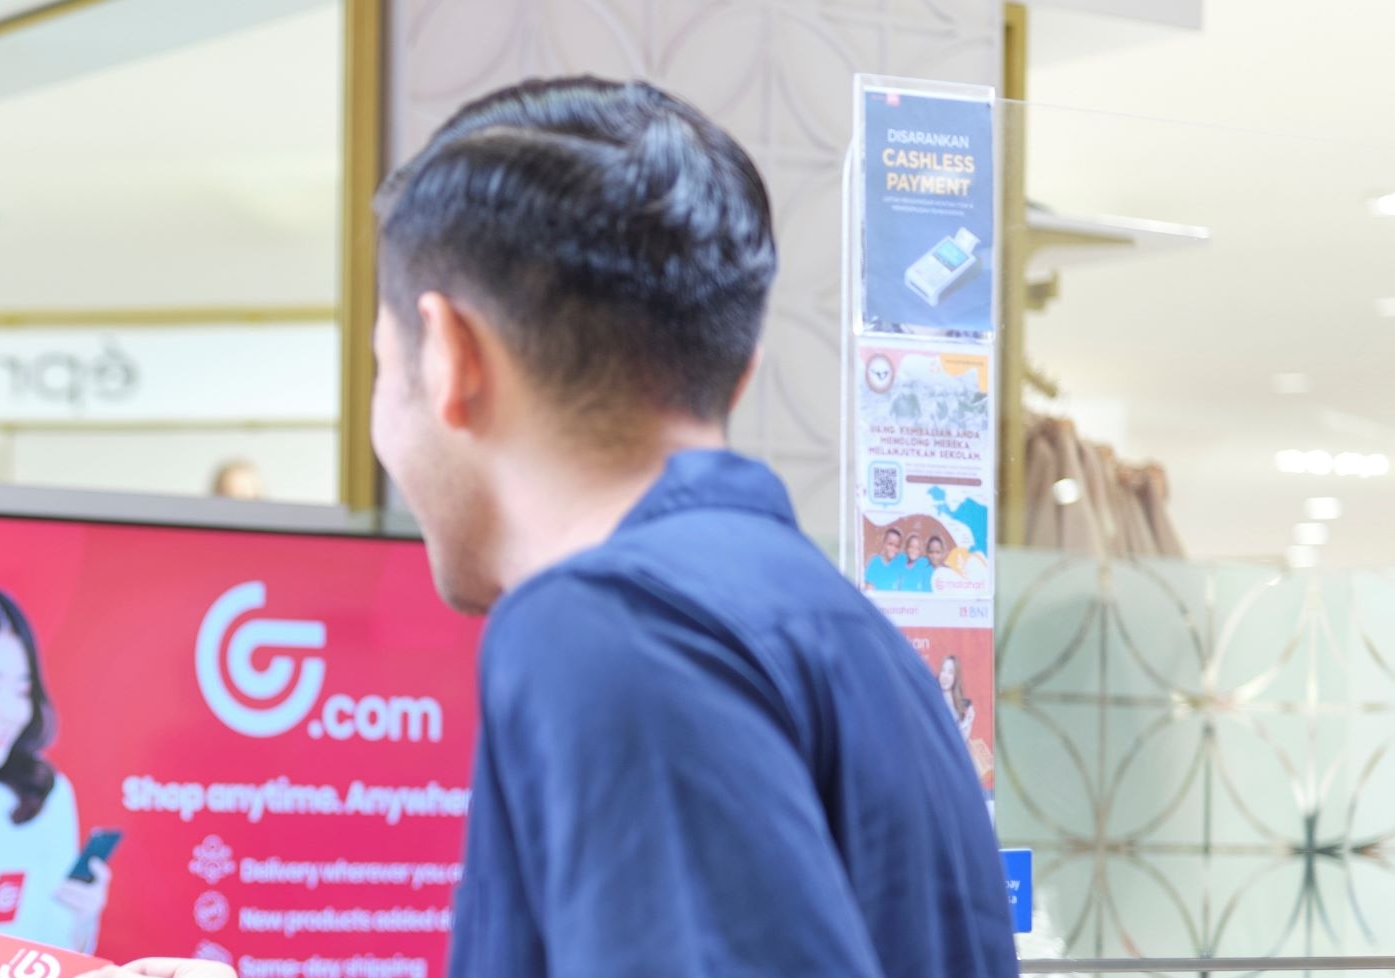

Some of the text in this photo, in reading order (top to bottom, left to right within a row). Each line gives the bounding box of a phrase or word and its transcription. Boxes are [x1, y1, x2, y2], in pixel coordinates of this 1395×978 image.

[887, 129, 969, 148] DISARANKAN
[882, 148, 975, 173] CASHLESS
[886, 173, 971, 196] PAYMENT
[969, 606, 989, 618] BNI
[121, 775, 205, 822] Shop
[206, 776, 344, 823] anytime.
[240, 857, 319, 890] Delivery
[321, 858, 409, 884] wherever
[411, 863, 446, 890] you
[239, 907, 282, 932] New
[283, 906, 371, 937] products
[372, 906, 436, 932] added
